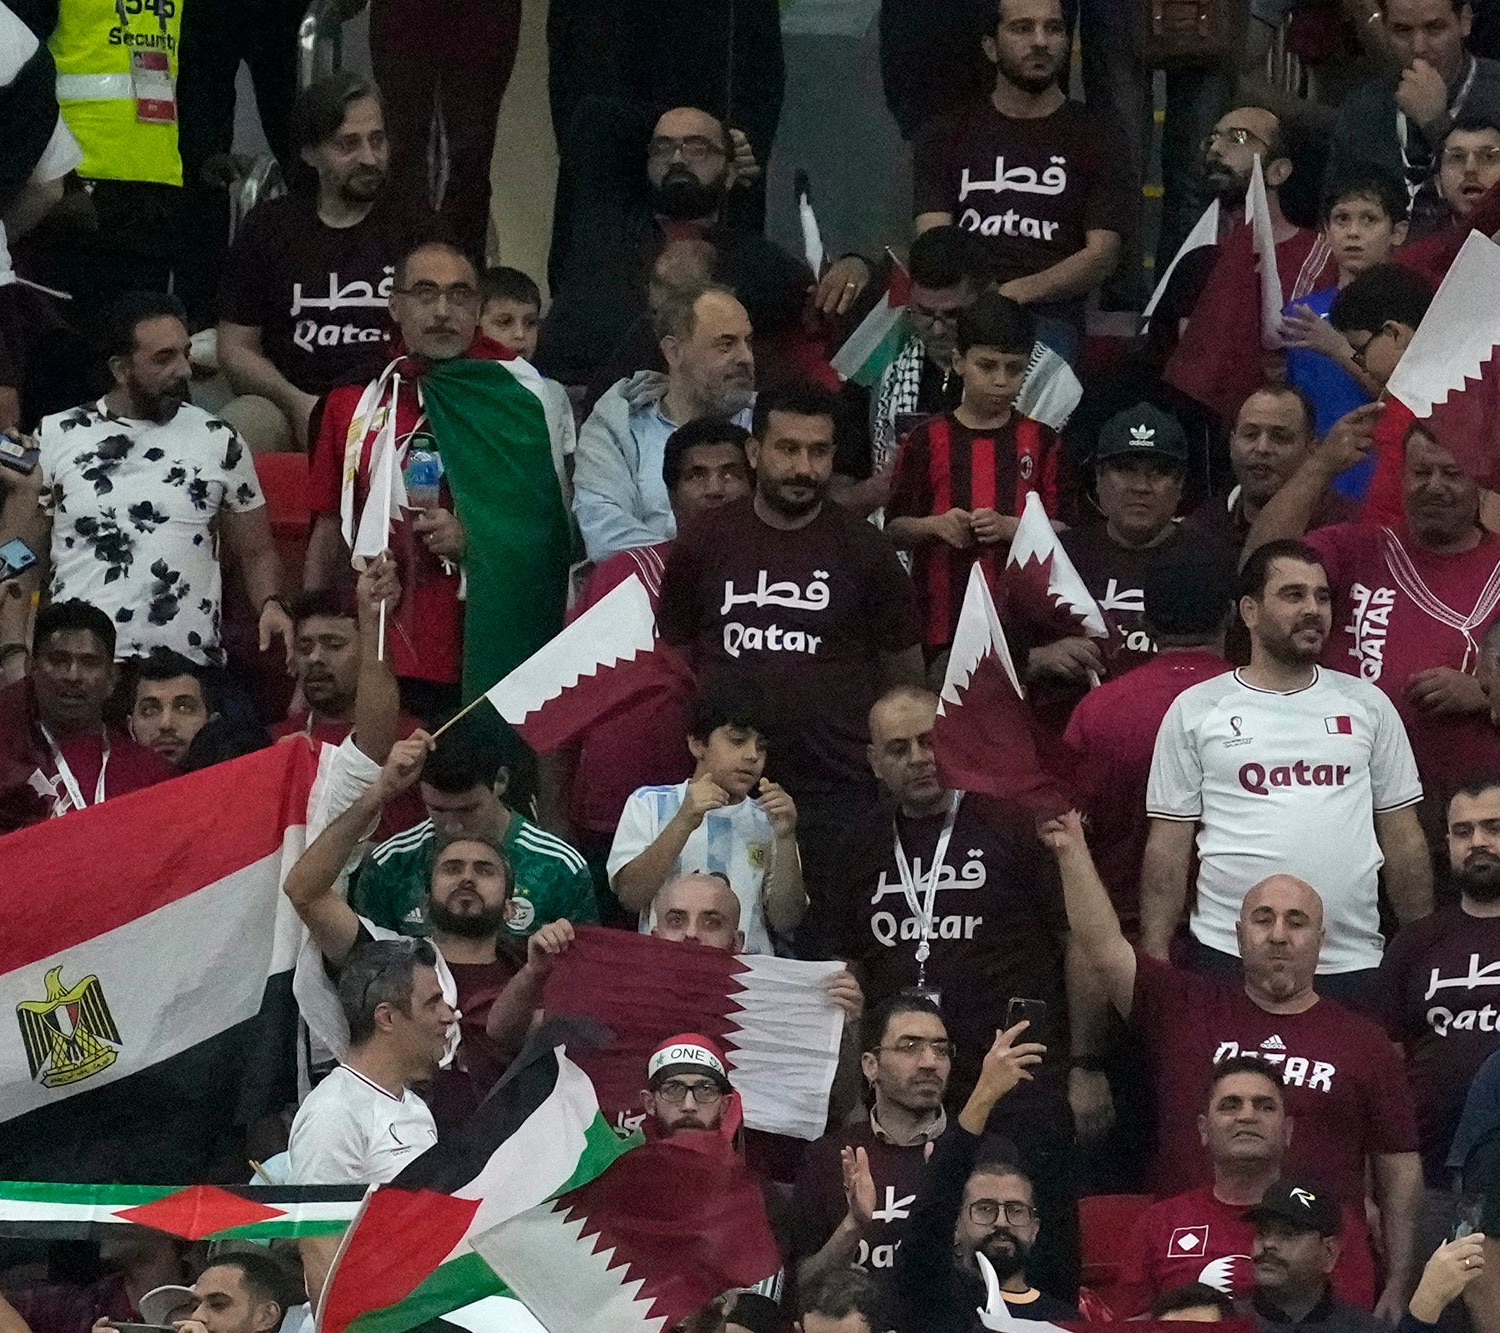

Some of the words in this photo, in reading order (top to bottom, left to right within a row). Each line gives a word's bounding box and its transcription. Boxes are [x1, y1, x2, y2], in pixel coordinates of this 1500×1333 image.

[959, 156, 1066, 195] قطر
[959, 209, 1058, 240] Qatar
[721, 570, 829, 615] قطر
[724, 623, 821, 657] Qatar
[1360, 586, 1396, 682] QATAR
[1238, 760, 1351, 795] Qatar
